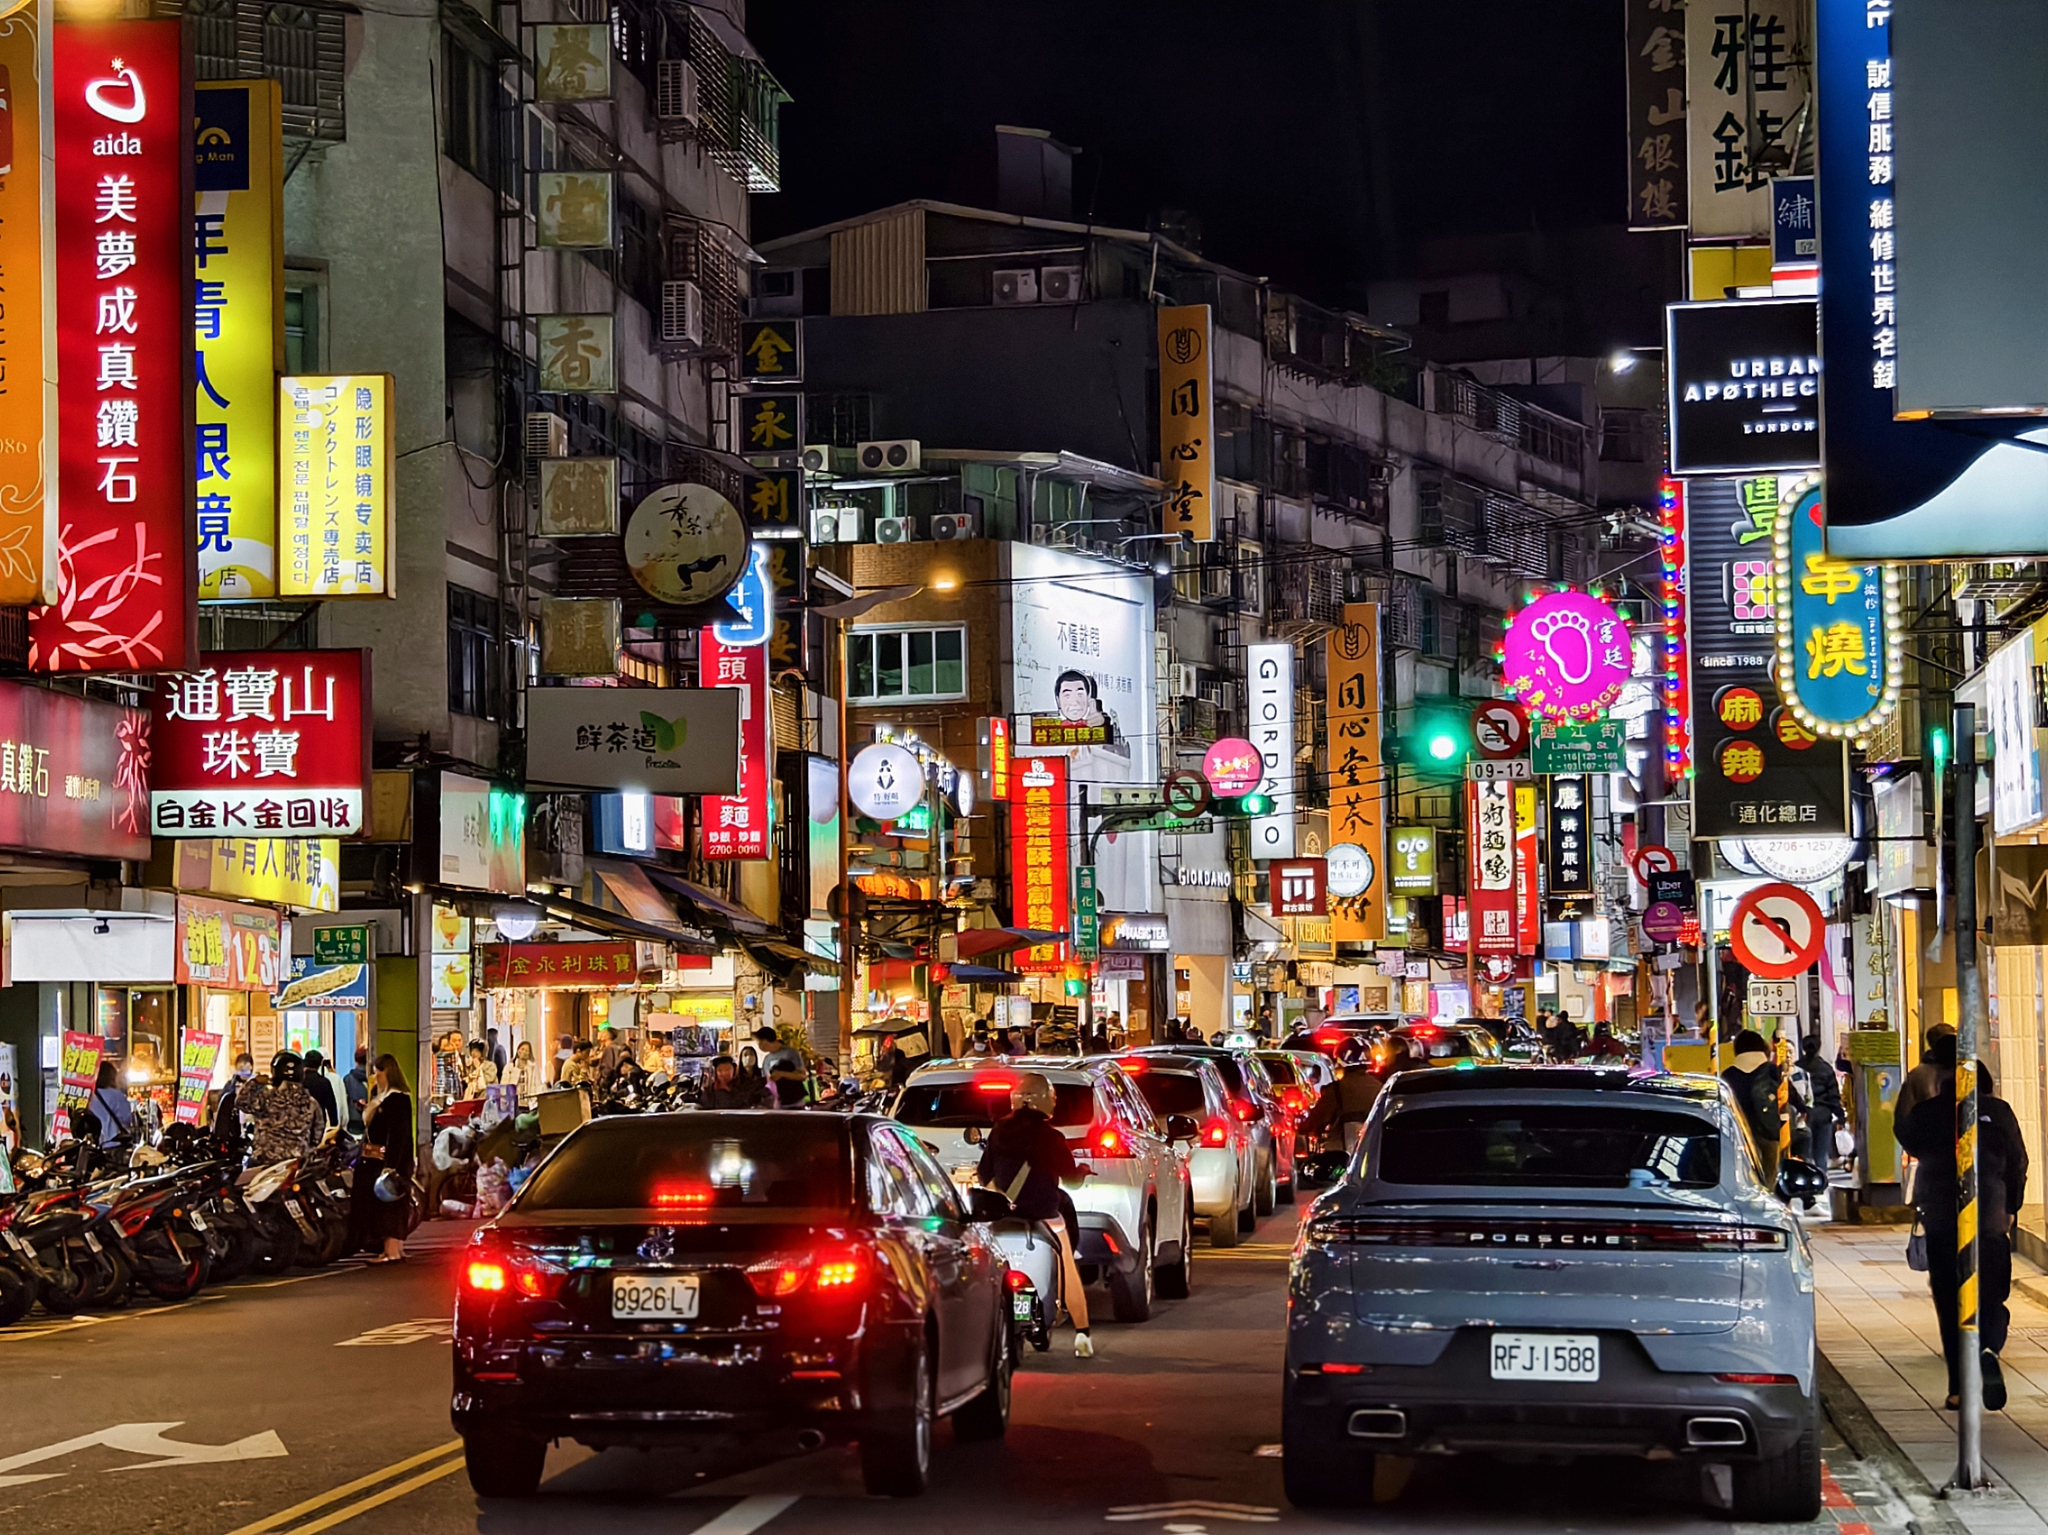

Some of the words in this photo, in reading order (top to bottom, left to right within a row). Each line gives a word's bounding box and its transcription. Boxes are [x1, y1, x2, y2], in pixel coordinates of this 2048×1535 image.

[92, 132, 143, 155] aida
[94, 174, 139, 504] 美夢成真鑽石
[1730, 358, 1820, 378] URBAN
[1742, 421, 1816, 434] LONDON
[1169, 378, 1204, 523] 同心堂
[322, 385, 340, 585] コンタクトレンズ専売店
[354, 387, 374, 584] 隐形眼镜专卖店
[1593, 616, 1629, 670] 宮廷
[1737, 654, 1763, 667] 1988
[165, 666, 336, 722] 通寶山
[1544, 682, 1621, 717] MASSAGE
[575, 721, 657, 754] 鮮茶道
[1720, 695, 1764, 777] 麻辣
[202, 729, 301, 780] 珠寶
[1258, 658, 1281, 845] GIORDAO
[1474, 762, 1525, 779] 09-12
[156, 797, 351, 830] 白金K金回收
[1738, 804, 1818, 824] 通化總店
[709, 844, 761, 856] 2700-0010
[1769, 841, 1834, 852] 2706-1257
[1178, 868, 1231, 888] GIORDANO
[1656, 881, 1682, 891] Uber
[1657, 890, 1683, 900] Eats
[1299, 922, 1333, 944] KEBUKE
[510, 954, 633, 976] 金永利珠寶
[1755, 1000, 1793, 1012] 15-17
[1469, 1232, 1621, 1245] PORSCHE
